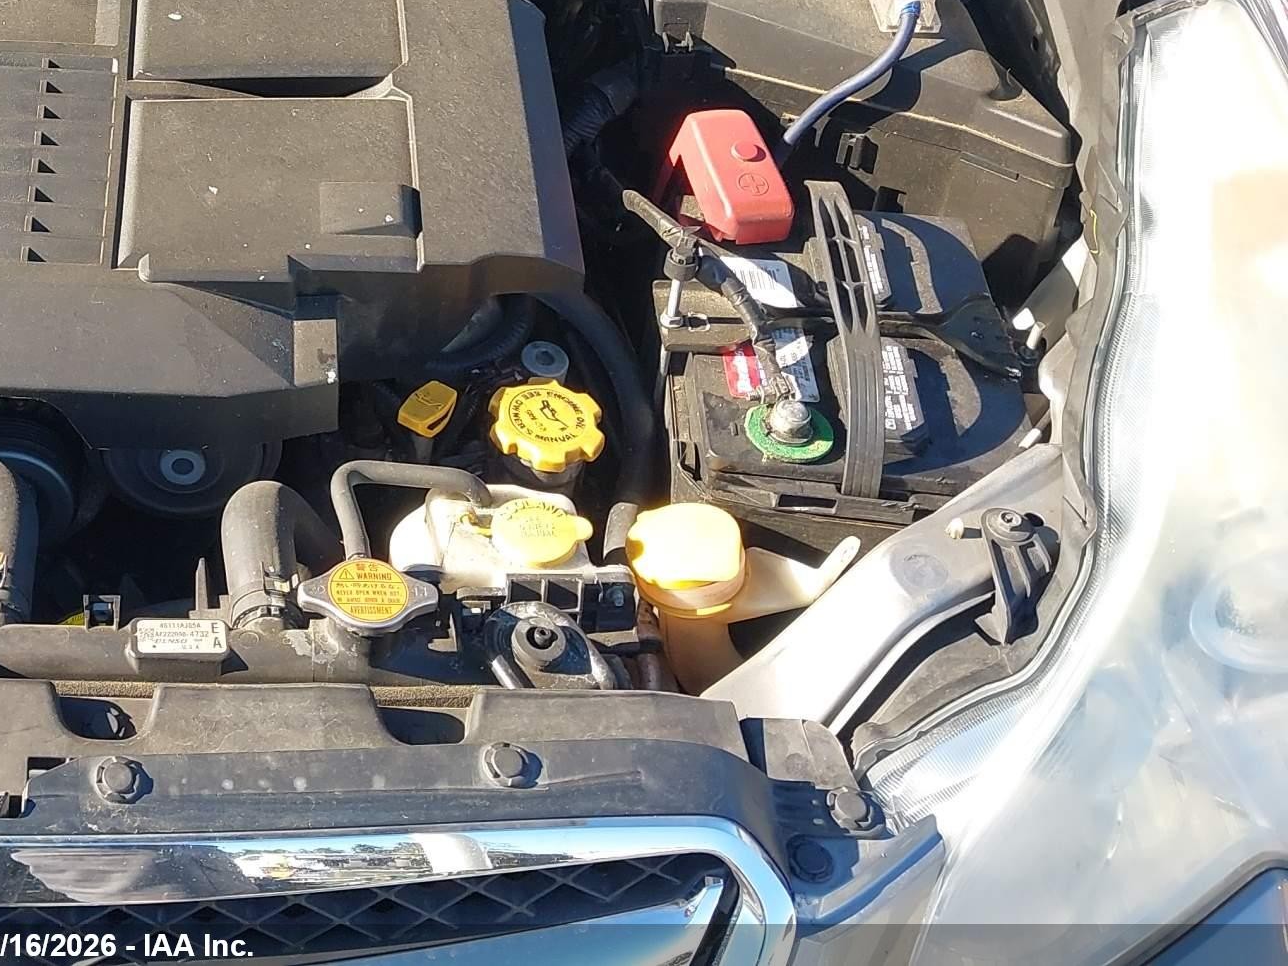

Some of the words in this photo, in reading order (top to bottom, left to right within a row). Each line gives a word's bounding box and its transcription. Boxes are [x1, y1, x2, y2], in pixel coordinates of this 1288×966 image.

[521, 390, 542, 400] SEE
[534, 432, 578, 443] MANUAL
[546, 391, 584, 416] ENGINE
[575, 416, 587, 430] OIL
[356, 572, 392, 581] WARNING
[211, 622, 220, 634] E
[213, 636, 222, 649] A
